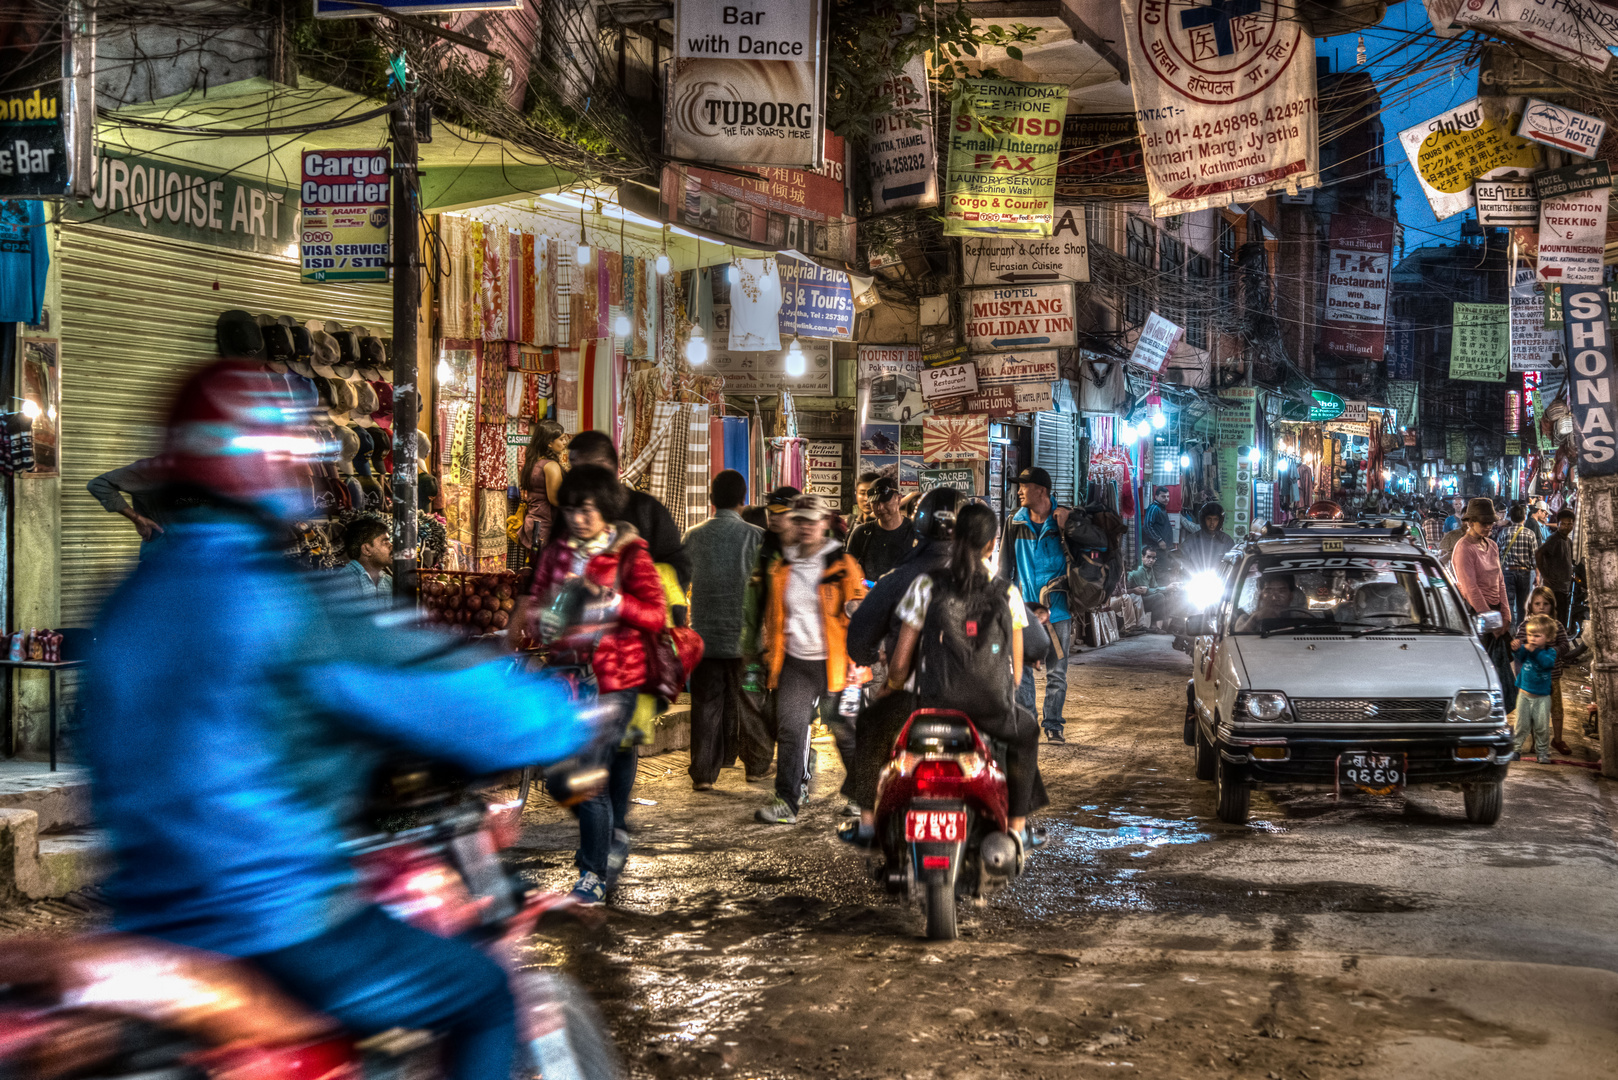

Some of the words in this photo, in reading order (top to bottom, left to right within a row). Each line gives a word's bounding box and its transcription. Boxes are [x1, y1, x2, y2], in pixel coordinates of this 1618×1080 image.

[722, 6, 765, 25] Bar
[1519, 8, 1553, 31] Blind
[688, 34, 729, 53] with
[738, 35, 803, 55] Dance
[1004, 100, 1051, 112] PHONE
[705, 100, 811, 129] TUBORG
[722, 126, 737, 137] THE
[740, 125, 754, 136] FUN
[757, 127, 785, 139] STARTS
[788, 128, 811, 139] HERE
[1069, 121, 1128, 132] Treatment
[1570, 117, 1601, 135] FUJI
[896, 134, 926, 149] THAMEL
[1199, 139, 1243, 159] Marg,
[1247, 125, 1299, 151] Jyatha
[1565, 129, 1596, 148] HOTEL
[953, 136, 994, 151] E-mail
[1007, 139, 1059, 154] Internet
[15, 140, 54, 174] Bar
[1420, 148, 1442, 161] TOURS
[305, 154, 387, 178] Cargo
[974, 154, 1036, 171] FAX
[1200, 152, 1266, 177] Kathmandu
[951, 174, 1002, 184] LAUNDRY
[1006, 177, 1053, 186] SERVICE
[1241, 176, 1256, 187] 78
[1538, 175, 1562, 186] HOTEL
[1540, 186, 1567, 196] SACRED
[1568, 179, 1596, 190] VALLEY
[1596, 176, 1610, 185] INN
[302, 180, 389, 204] Courier
[1009, 186, 1032, 194] Wash
[79, 157, 225, 230] URQUOISE
[230, 185, 284, 240] ART
[992, 198, 1000, 207] &
[1005, 199, 1048, 209] Courier
[1480, 204, 1508, 212] ARCHITECTS
[1544, 203, 1602, 212] PROMOTION
[331, 208, 367, 216] ARAMEX
[370, 213, 388, 226] ups
[1545, 217, 1597, 227] TREKKING
[1053, 210, 1079, 237] A
[304, 233, 332, 241] TNT
[1566, 231, 1574, 239] &
[302, 246, 332, 256] VISA
[335, 244, 388, 255] SERVICE
[965, 244, 1015, 257] Restaurant
[1019, 246, 1025, 255] &
[1029, 243, 1060, 255] Coffee
[1064, 243, 1086, 257] Shop
[1540, 245, 1603, 254] MOUNTAINEERING
[305, 259, 334, 268] ISD
[352, 258, 386, 267] STD
[989, 262, 1028, 271] Eurasian
[1032, 262, 1063, 270] Cuisine
[1335, 253, 1383, 274] T.K.
[1330, 273, 1386, 289] Restaurant
[994, 289, 1037, 299] HOTEL
[1348, 291, 1364, 299] With
[811, 290, 846, 311] Tours
[1329, 298, 1361, 309] Dance
[1363, 300, 1381, 310] Bar
[1511, 297, 1530, 305] TREKS
[973, 298, 1063, 318] MUSTANG
[811, 311, 820, 319] Tel
[824, 313, 849, 322] 257380
[966, 319, 1041, 337] HOLIDAY
[1044, 316, 1074, 333] INN
[861, 350, 905, 361] TOURIST
[868, 363, 897, 372] Pokhara
[930, 366, 966, 379] GAIA
[1000, 362, 1056, 375] ADVENTURES
[934, 377, 966, 387] Restaurant
[1569, 291, 1616, 464] SHONAS
[1023, 393, 1036, 402] HOTEL
[969, 399, 989, 410] WHITE
[991, 398, 1013, 409] LOTUS
[810, 458, 837, 467] Thai
[938, 472, 967, 481] SACRED
[955, 481, 969, 490] INN
[1323, 542, 1343, 550] TAXI
[1279, 558, 1416, 569] SPORTS
